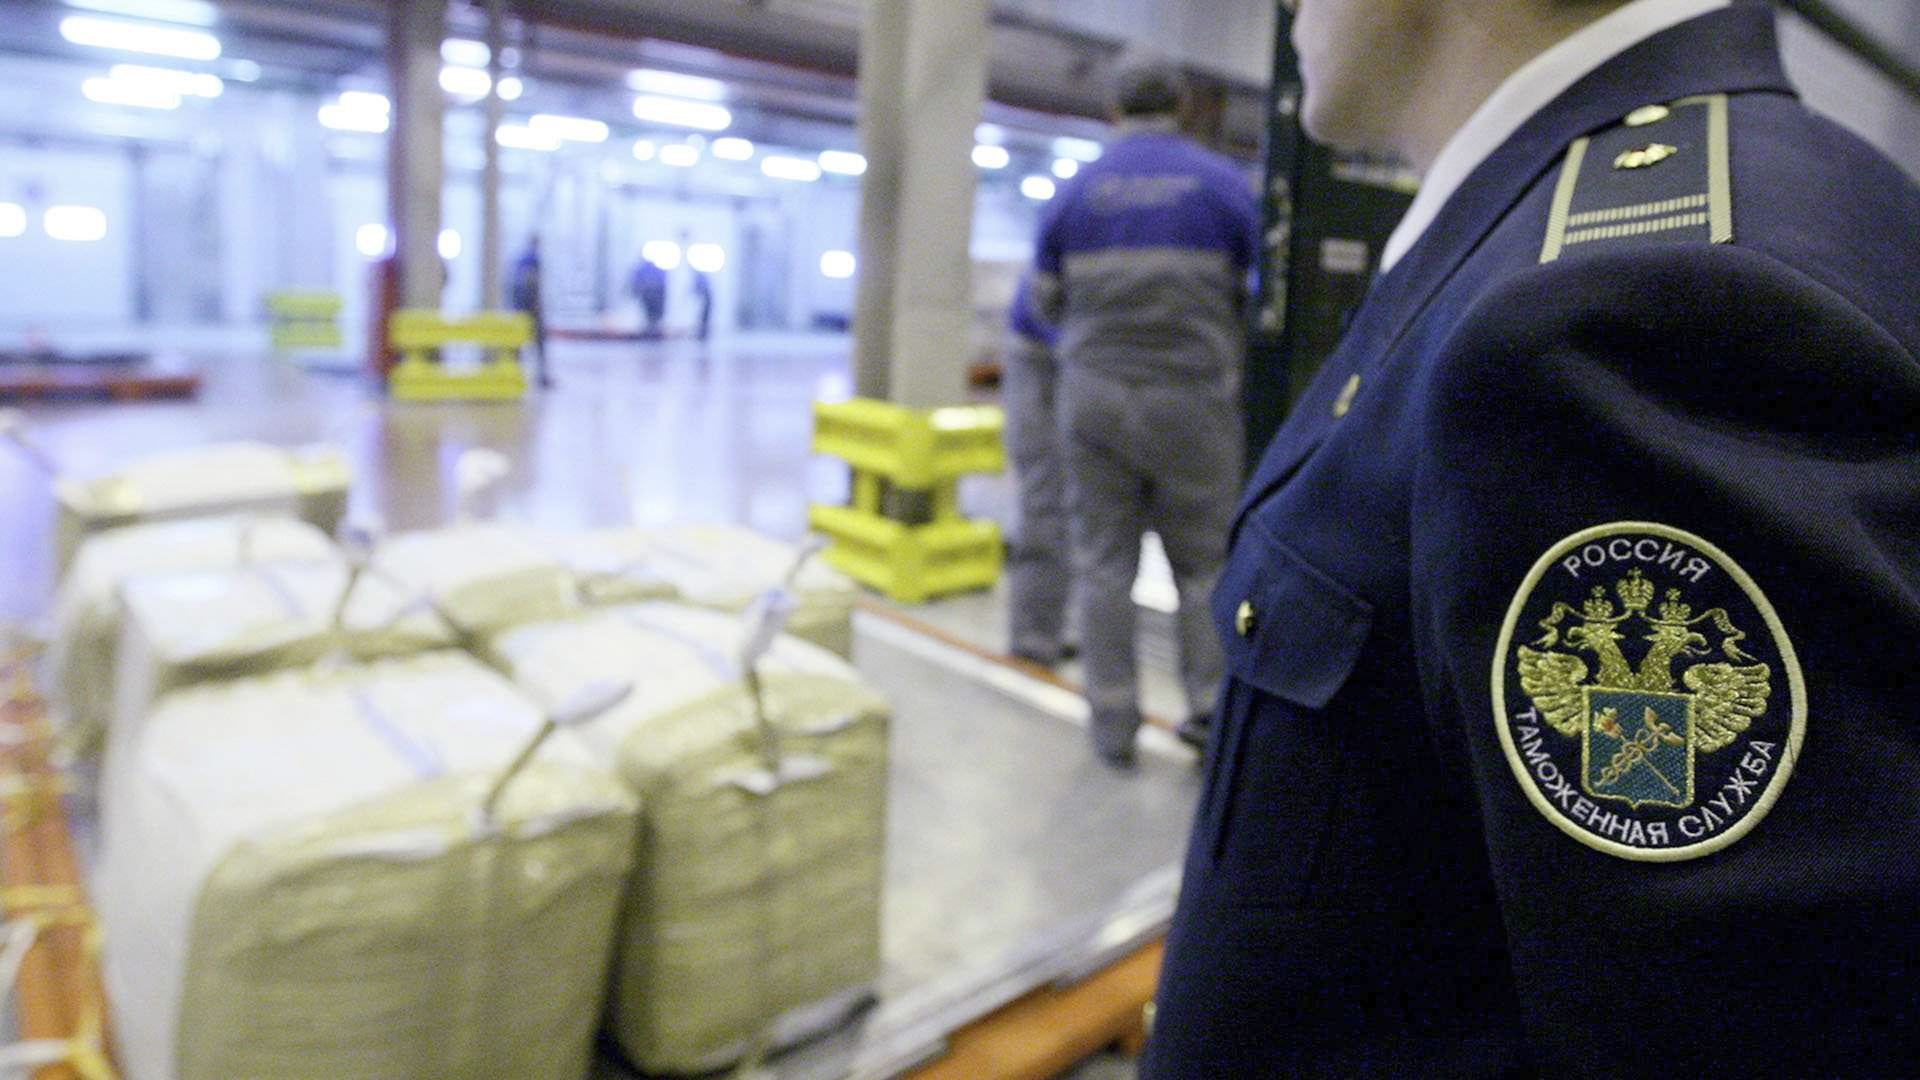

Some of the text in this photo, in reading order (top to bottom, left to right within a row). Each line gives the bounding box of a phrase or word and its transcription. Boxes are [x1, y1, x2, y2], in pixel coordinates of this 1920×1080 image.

[1562, 538, 1711, 583] РОССИЯ
[1515, 707, 1777, 846] ТАМОЖЕННАЯ СЛУЖБА
